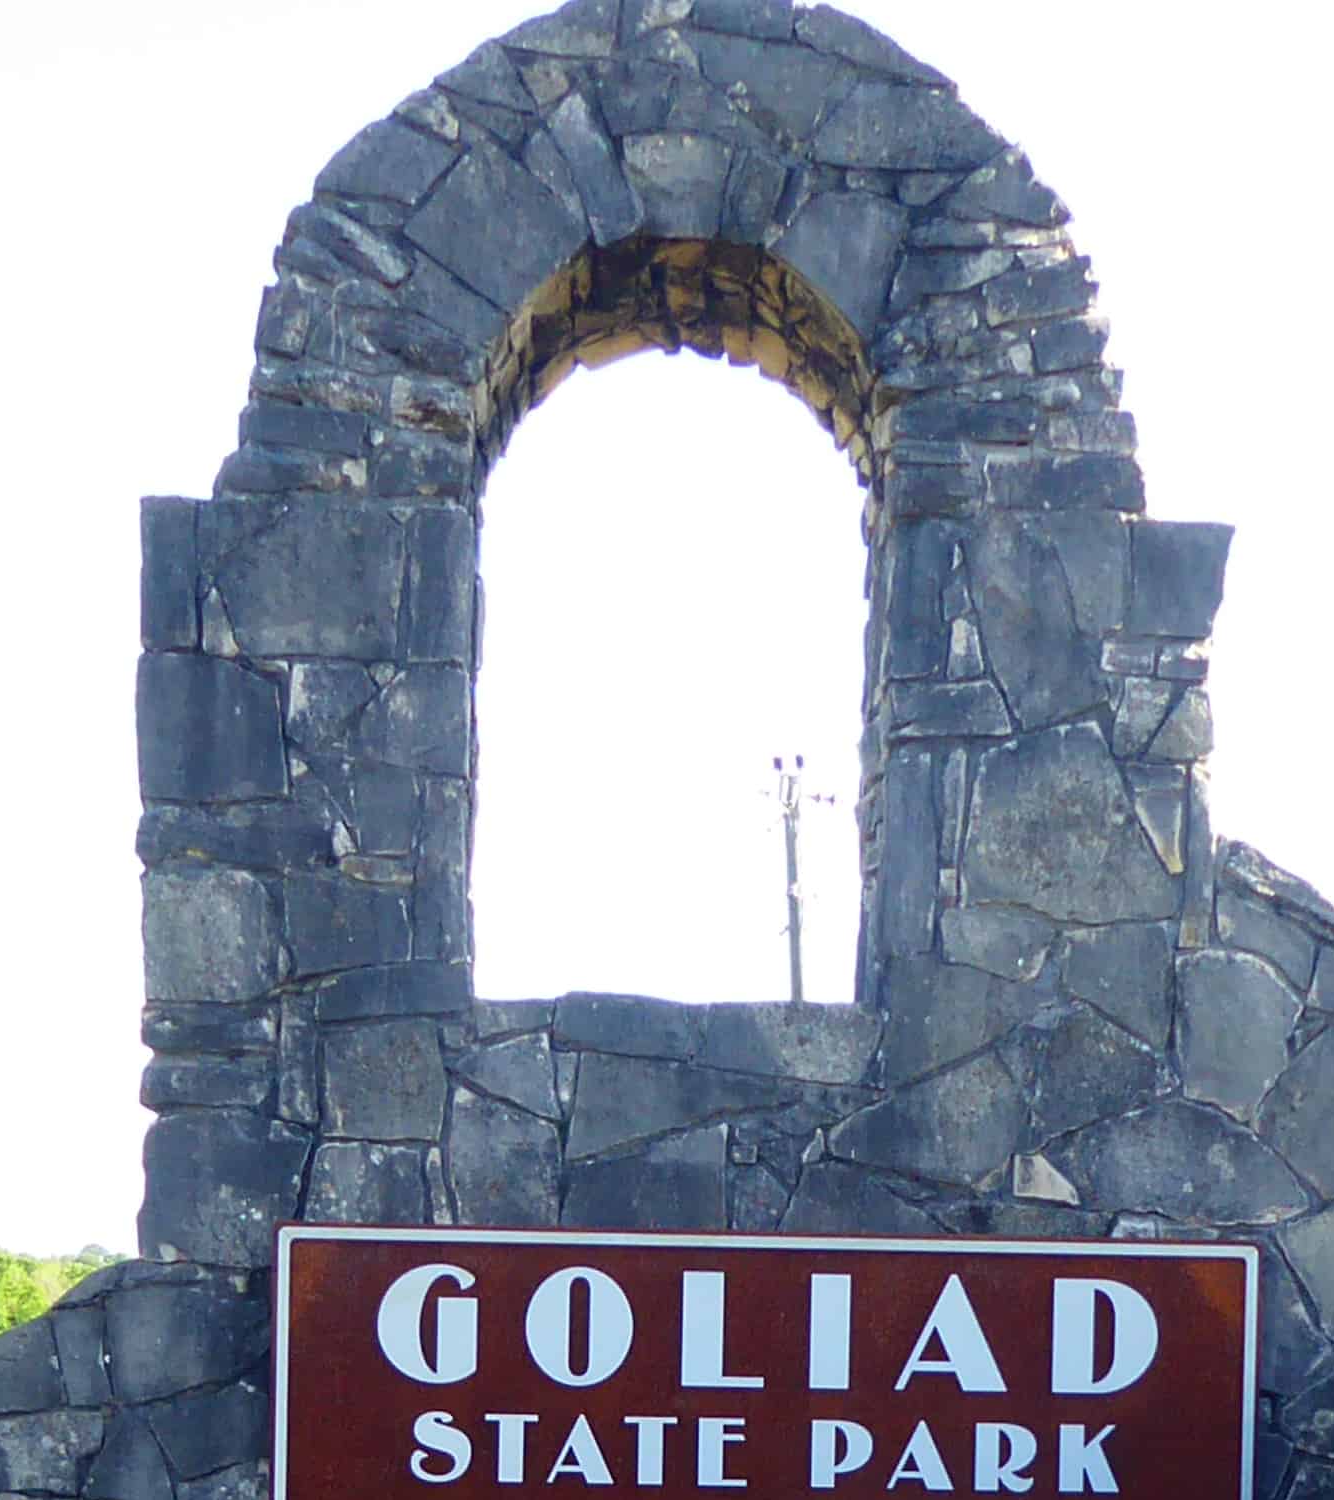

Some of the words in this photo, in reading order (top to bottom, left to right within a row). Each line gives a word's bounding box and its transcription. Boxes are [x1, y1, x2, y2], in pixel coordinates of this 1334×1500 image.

[376, 1263, 1159, 1395] GOLIAD
[410, 1410, 748, 1487] STATE
[810, 1418, 1119, 1494] PARK
